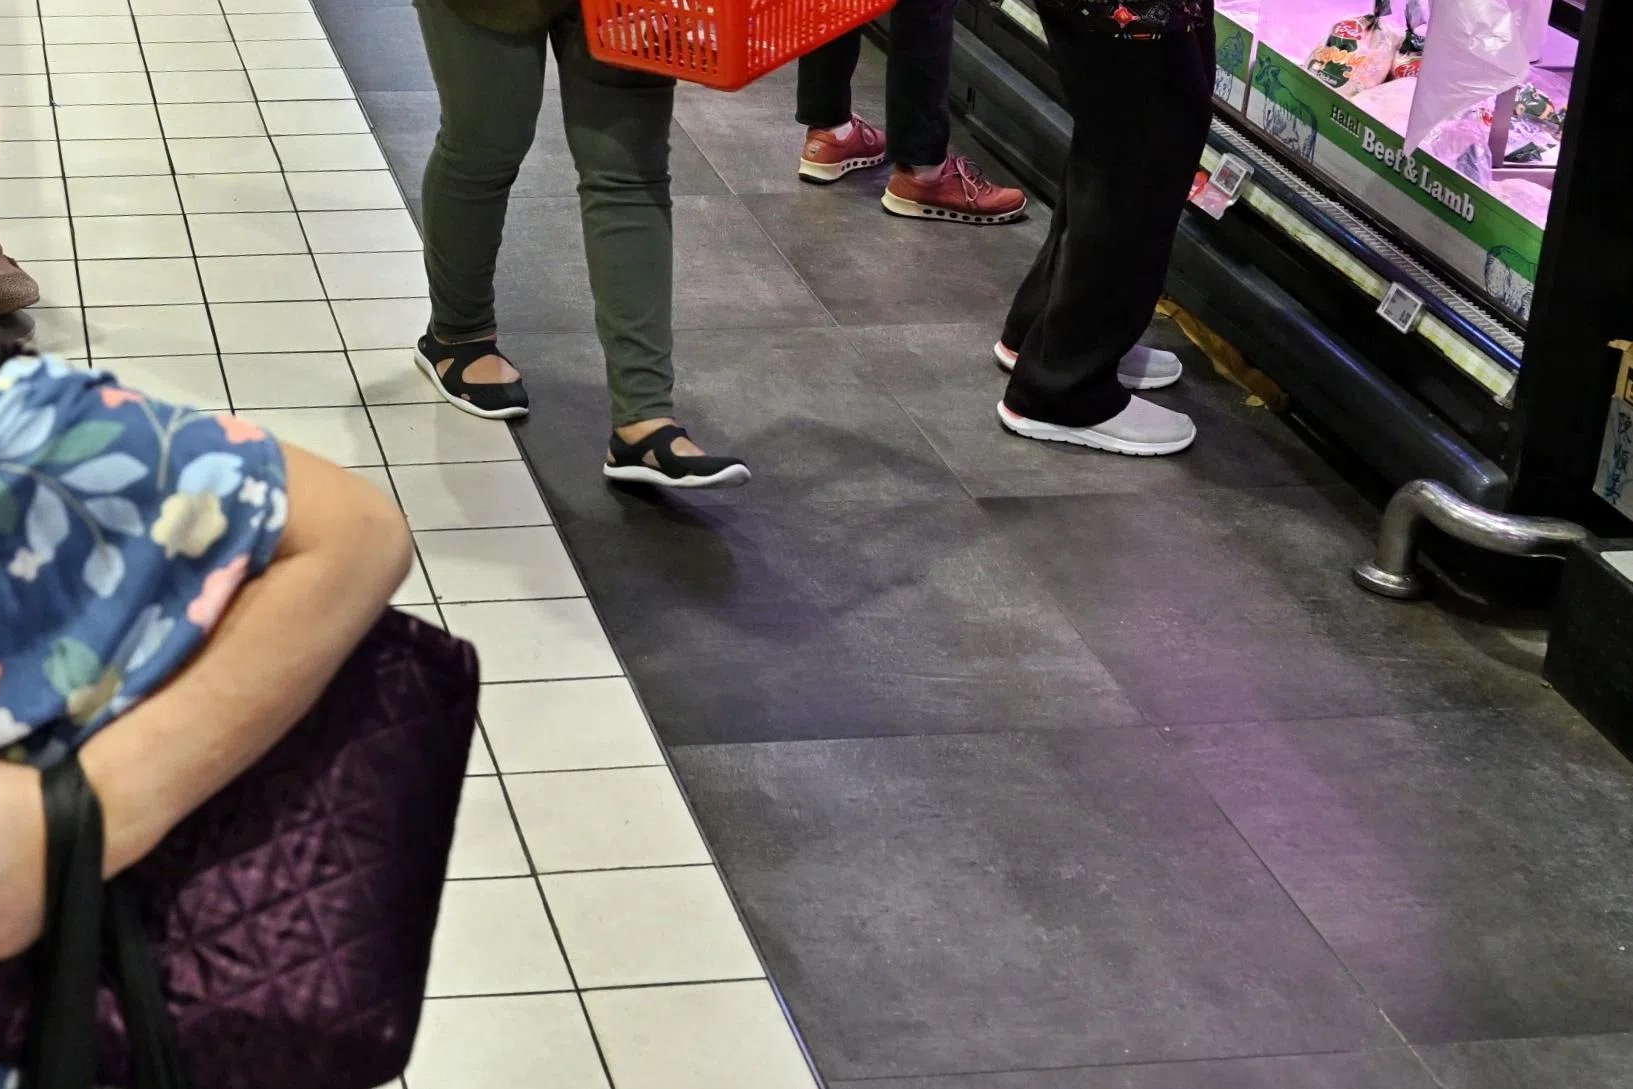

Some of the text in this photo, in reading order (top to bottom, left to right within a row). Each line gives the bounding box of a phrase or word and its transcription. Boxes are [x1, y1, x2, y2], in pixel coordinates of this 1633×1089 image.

[1330, 105, 1476, 223] Halal Beef & Lamb
